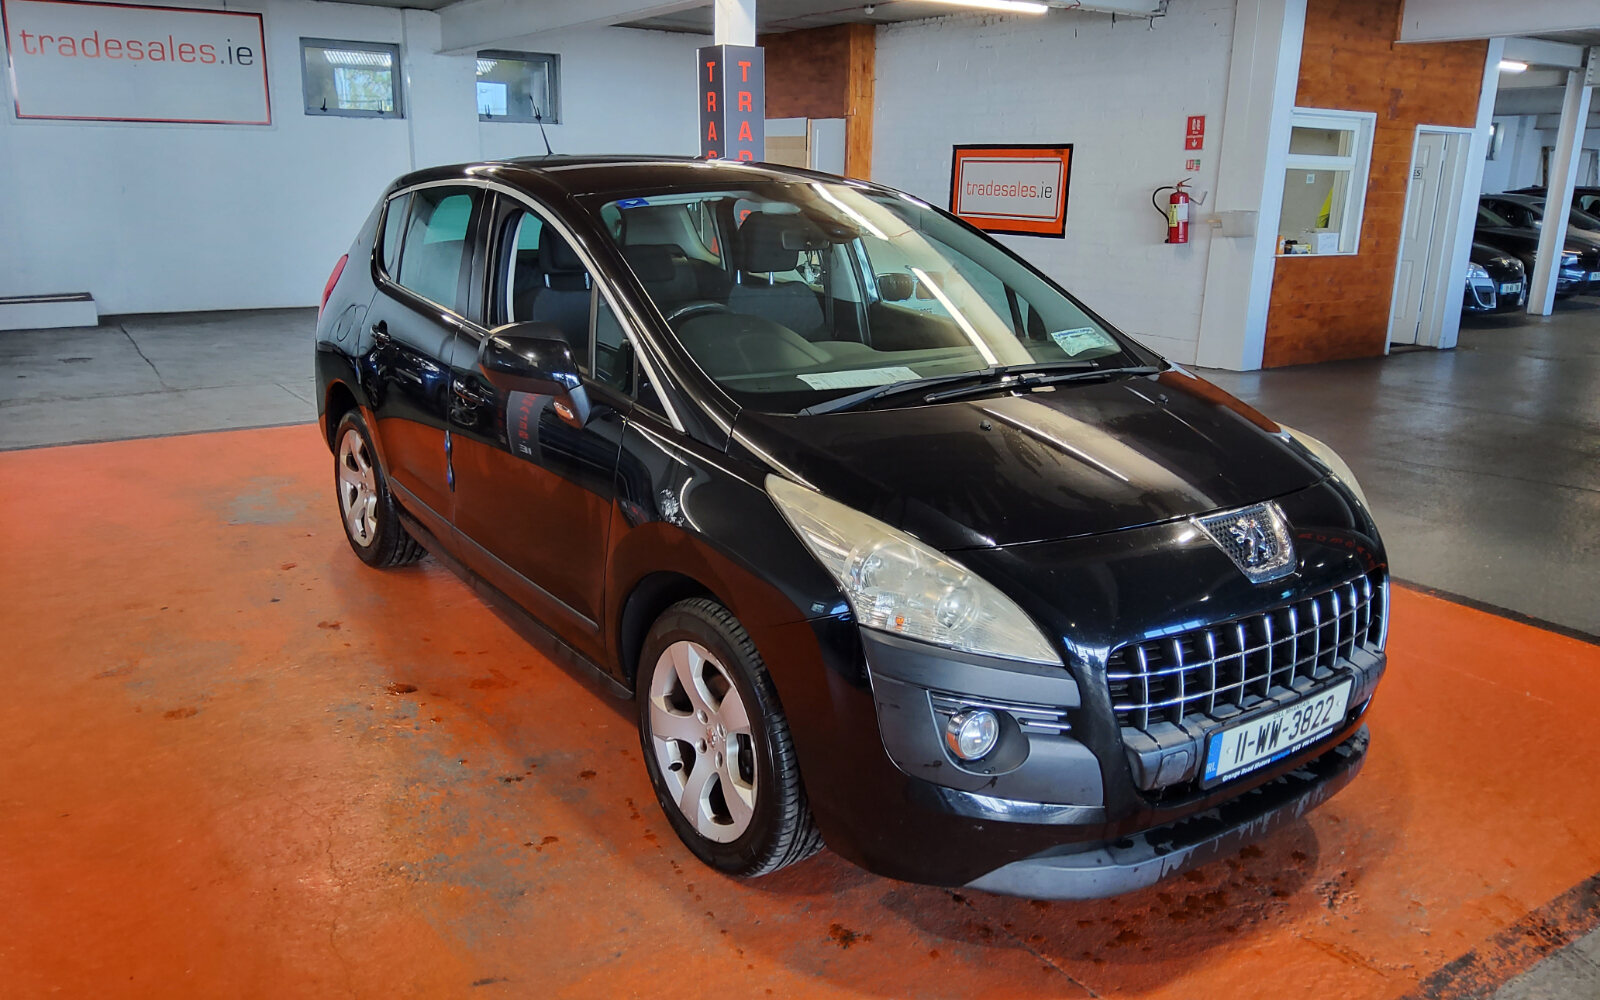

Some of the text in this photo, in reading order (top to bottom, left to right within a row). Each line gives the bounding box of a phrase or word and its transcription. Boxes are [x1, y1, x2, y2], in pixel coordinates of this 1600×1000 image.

[19, 29, 254, 66] tradesales.ie
[966, 179, 1053, 199] tradesales.ie
[1234, 694, 1335, 765] 11-WW-3822
